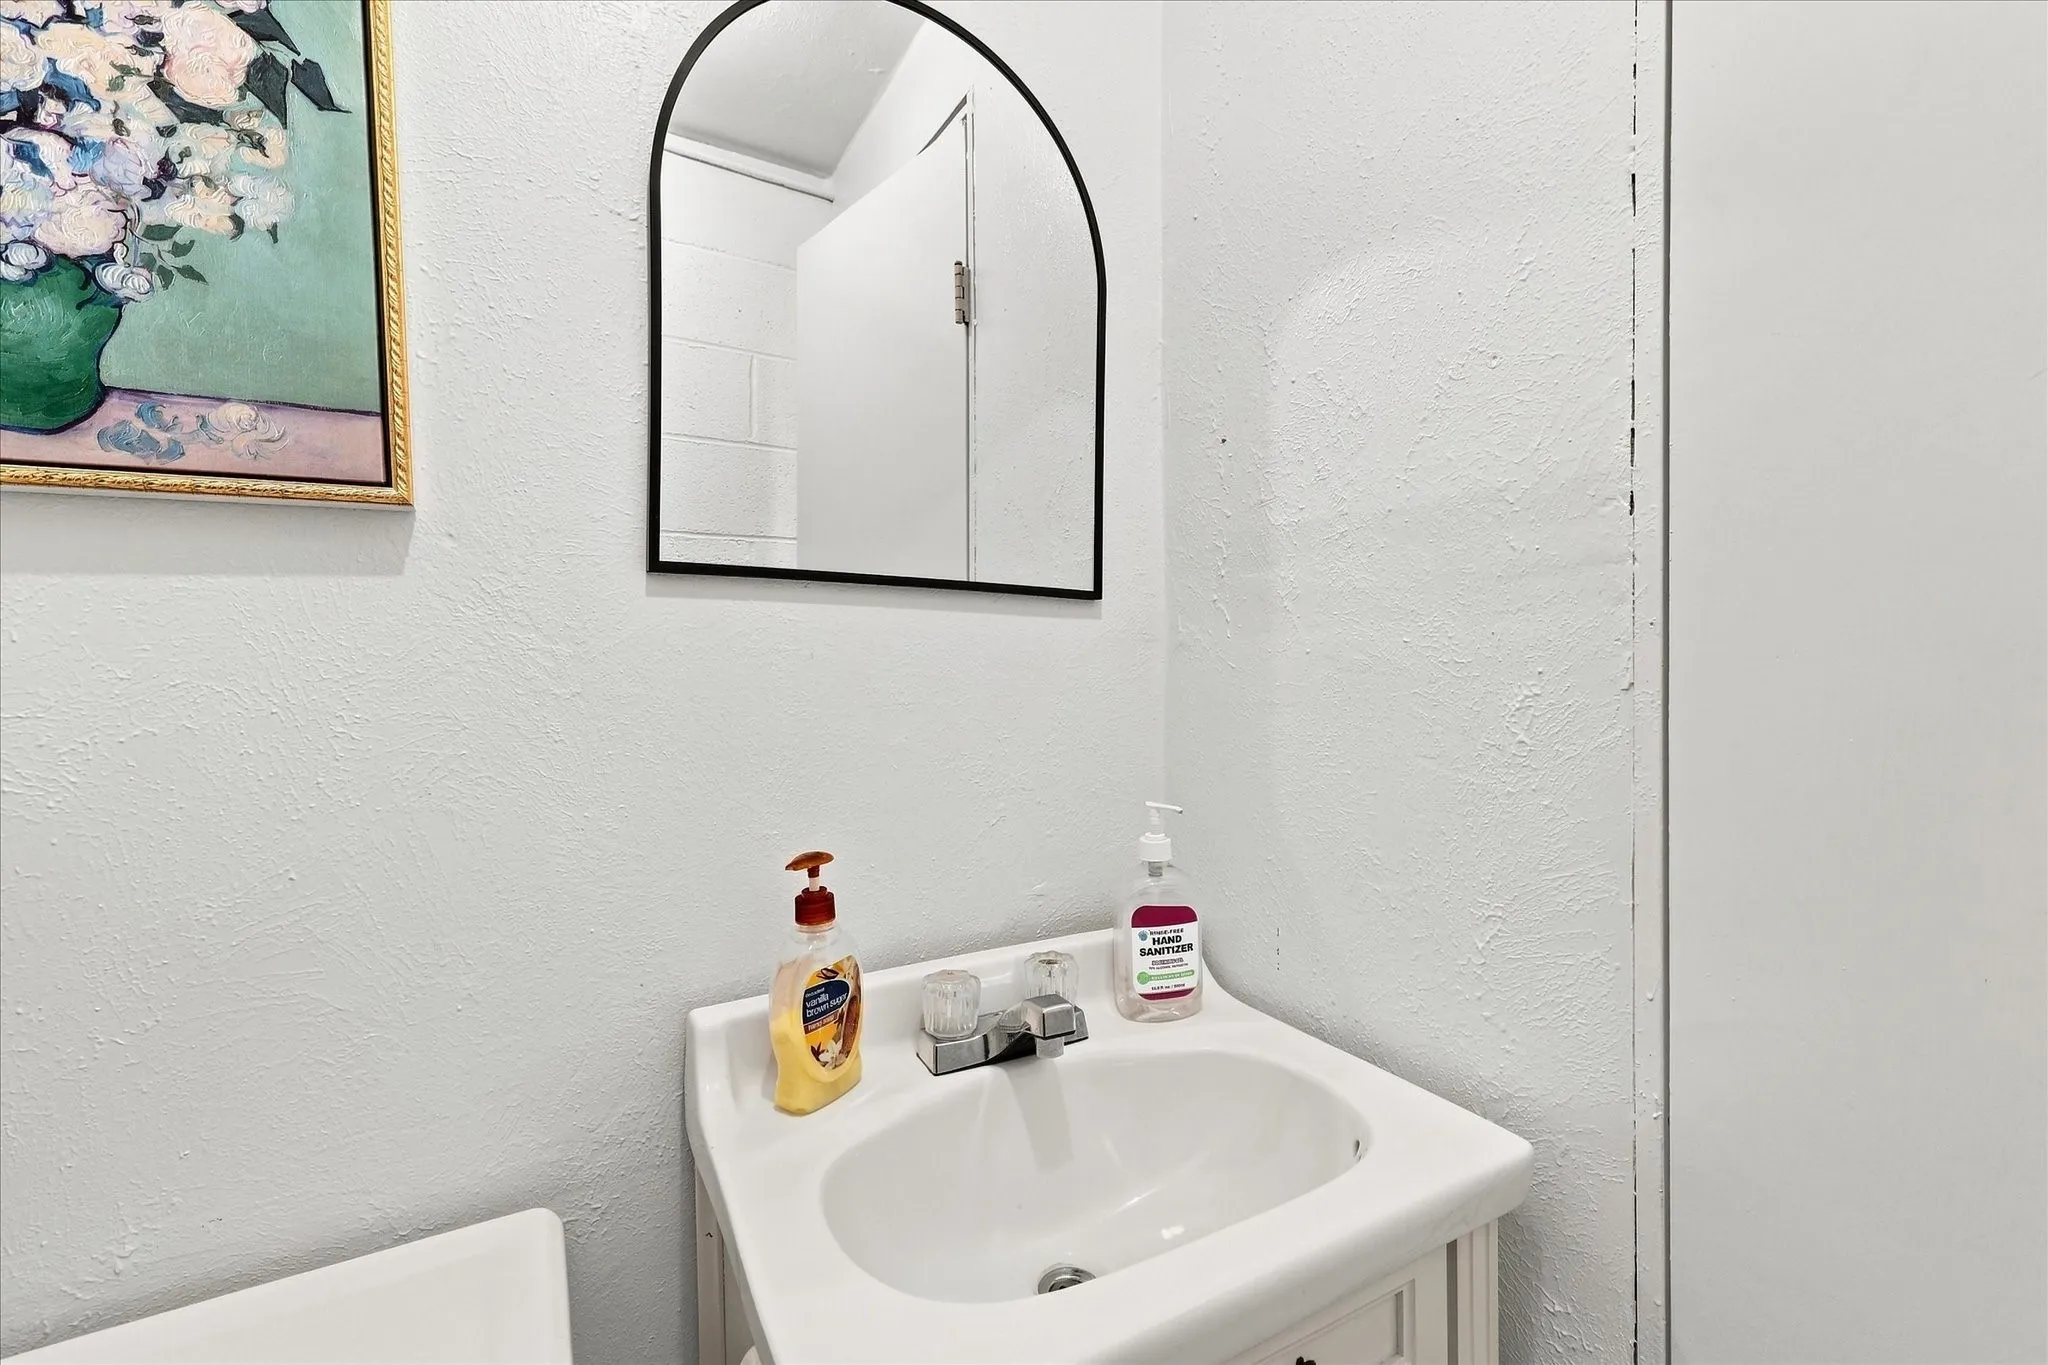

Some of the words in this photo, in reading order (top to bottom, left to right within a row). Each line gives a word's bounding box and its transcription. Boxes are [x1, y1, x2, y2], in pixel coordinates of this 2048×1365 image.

[1152, 935, 1182, 946] HAND
[1139, 943, 1194, 957] SANITIZER
[805, 993, 829, 1008] vanilla
[806, 1002, 829, 1018] brown
[829, 992, 848, 1007] sugar
